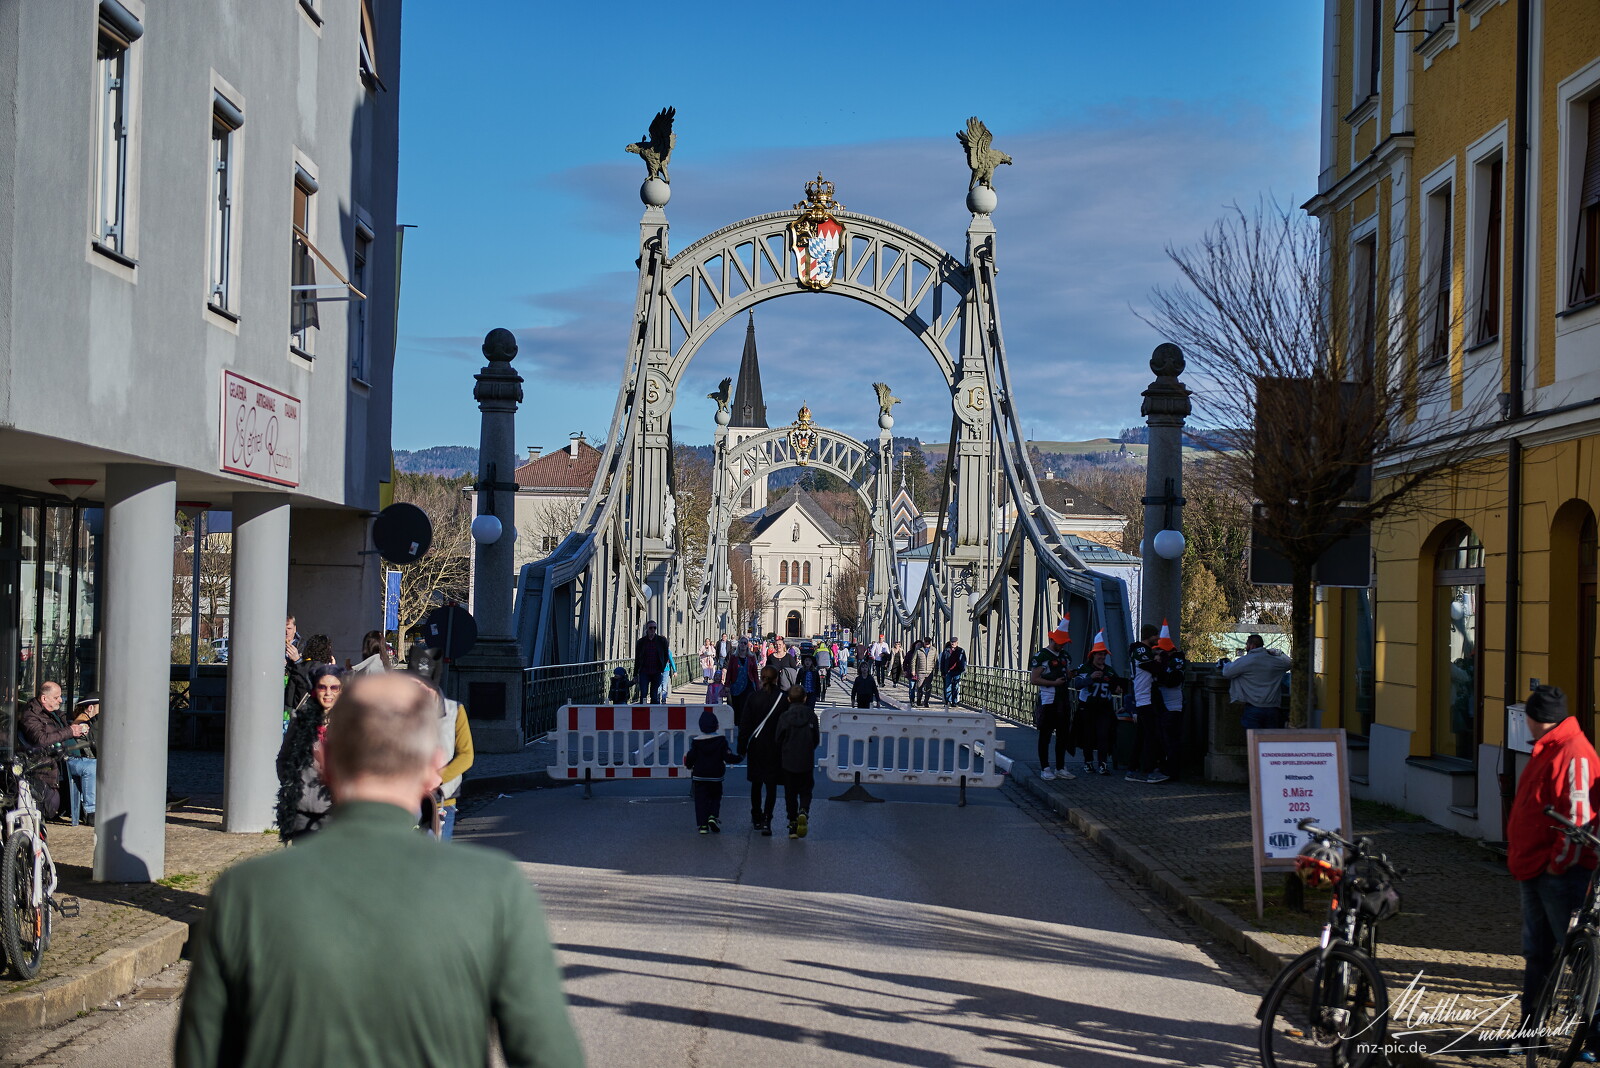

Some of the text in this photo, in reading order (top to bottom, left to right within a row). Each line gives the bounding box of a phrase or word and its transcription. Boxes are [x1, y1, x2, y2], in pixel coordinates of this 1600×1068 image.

[230, 382, 247, 402] GELATERIA
[1093, 683, 1109, 698] 75
[1282, 787, 1314, 798] 8.März
[1289, 802, 1311, 812] 2023
[1268, 834, 1298, 847] KMT
